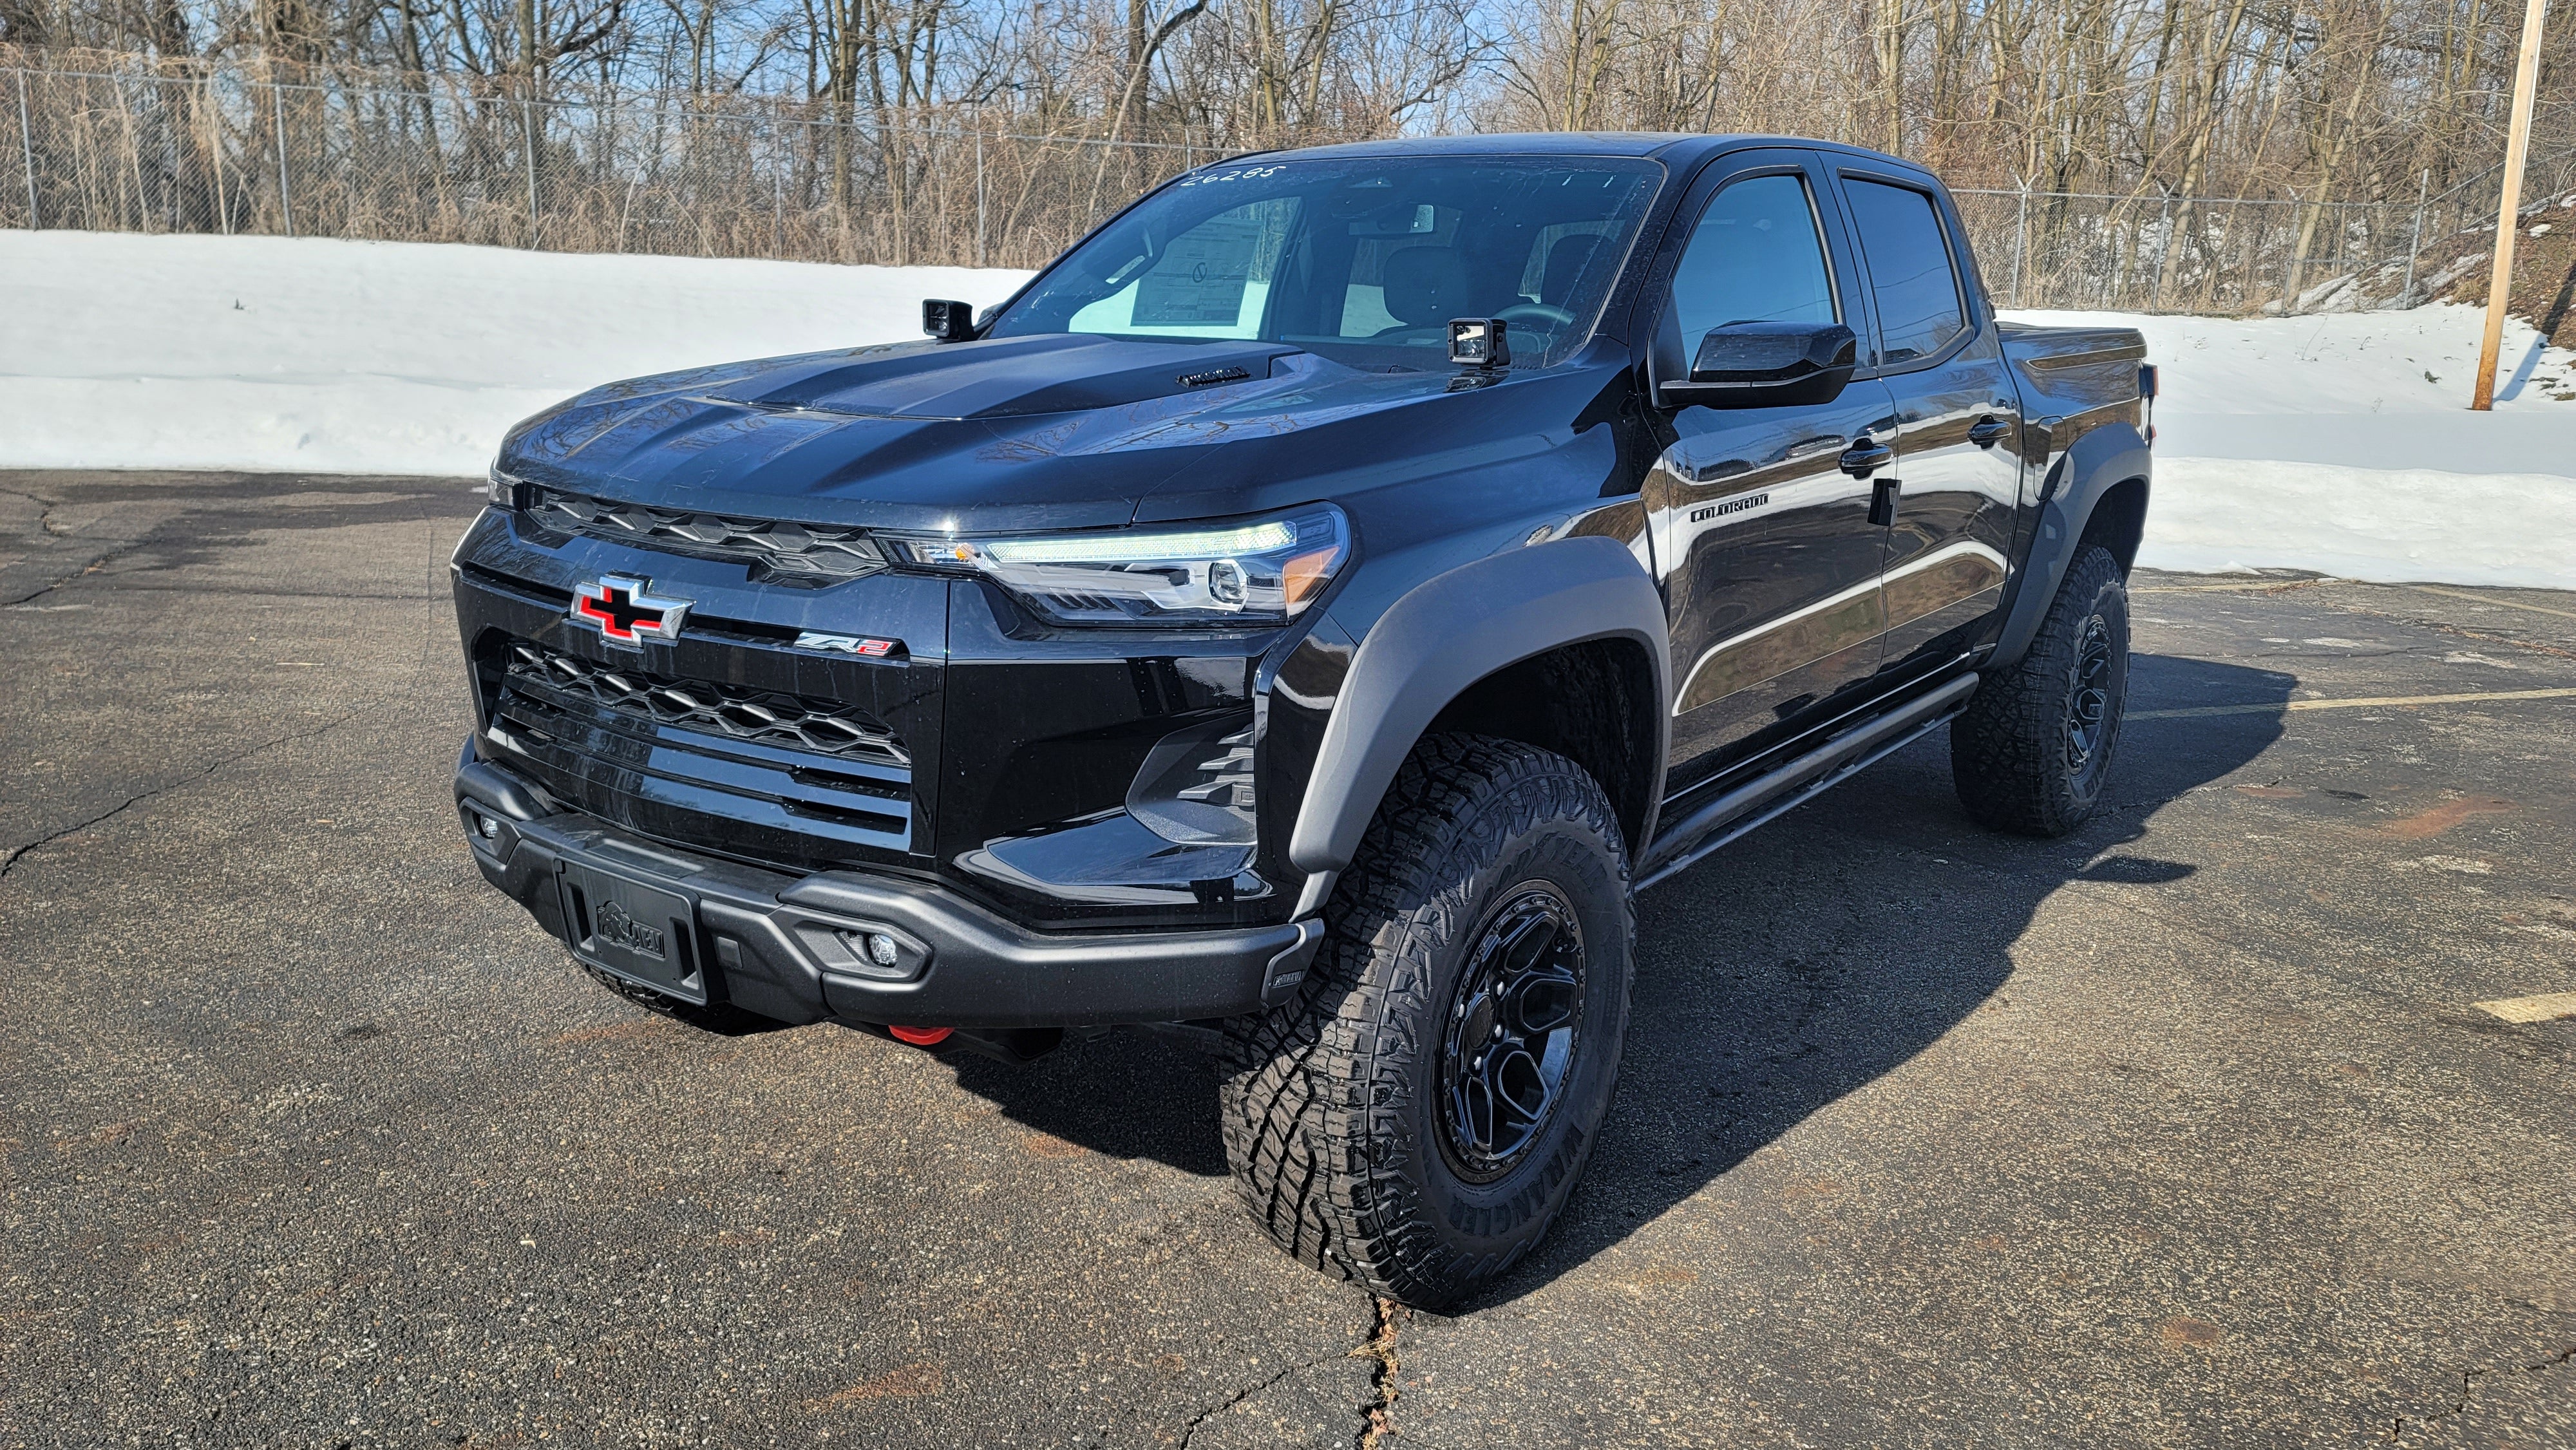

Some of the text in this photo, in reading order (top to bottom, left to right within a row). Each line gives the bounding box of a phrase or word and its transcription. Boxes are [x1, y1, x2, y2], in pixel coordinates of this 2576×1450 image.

[1180, 165, 1287, 187] 26285
[1690, 493, 1769, 523] COLORADO
[794, 632, 894, 657] ZR2
[1449, 1122, 1585, 1237] WRANGLER
